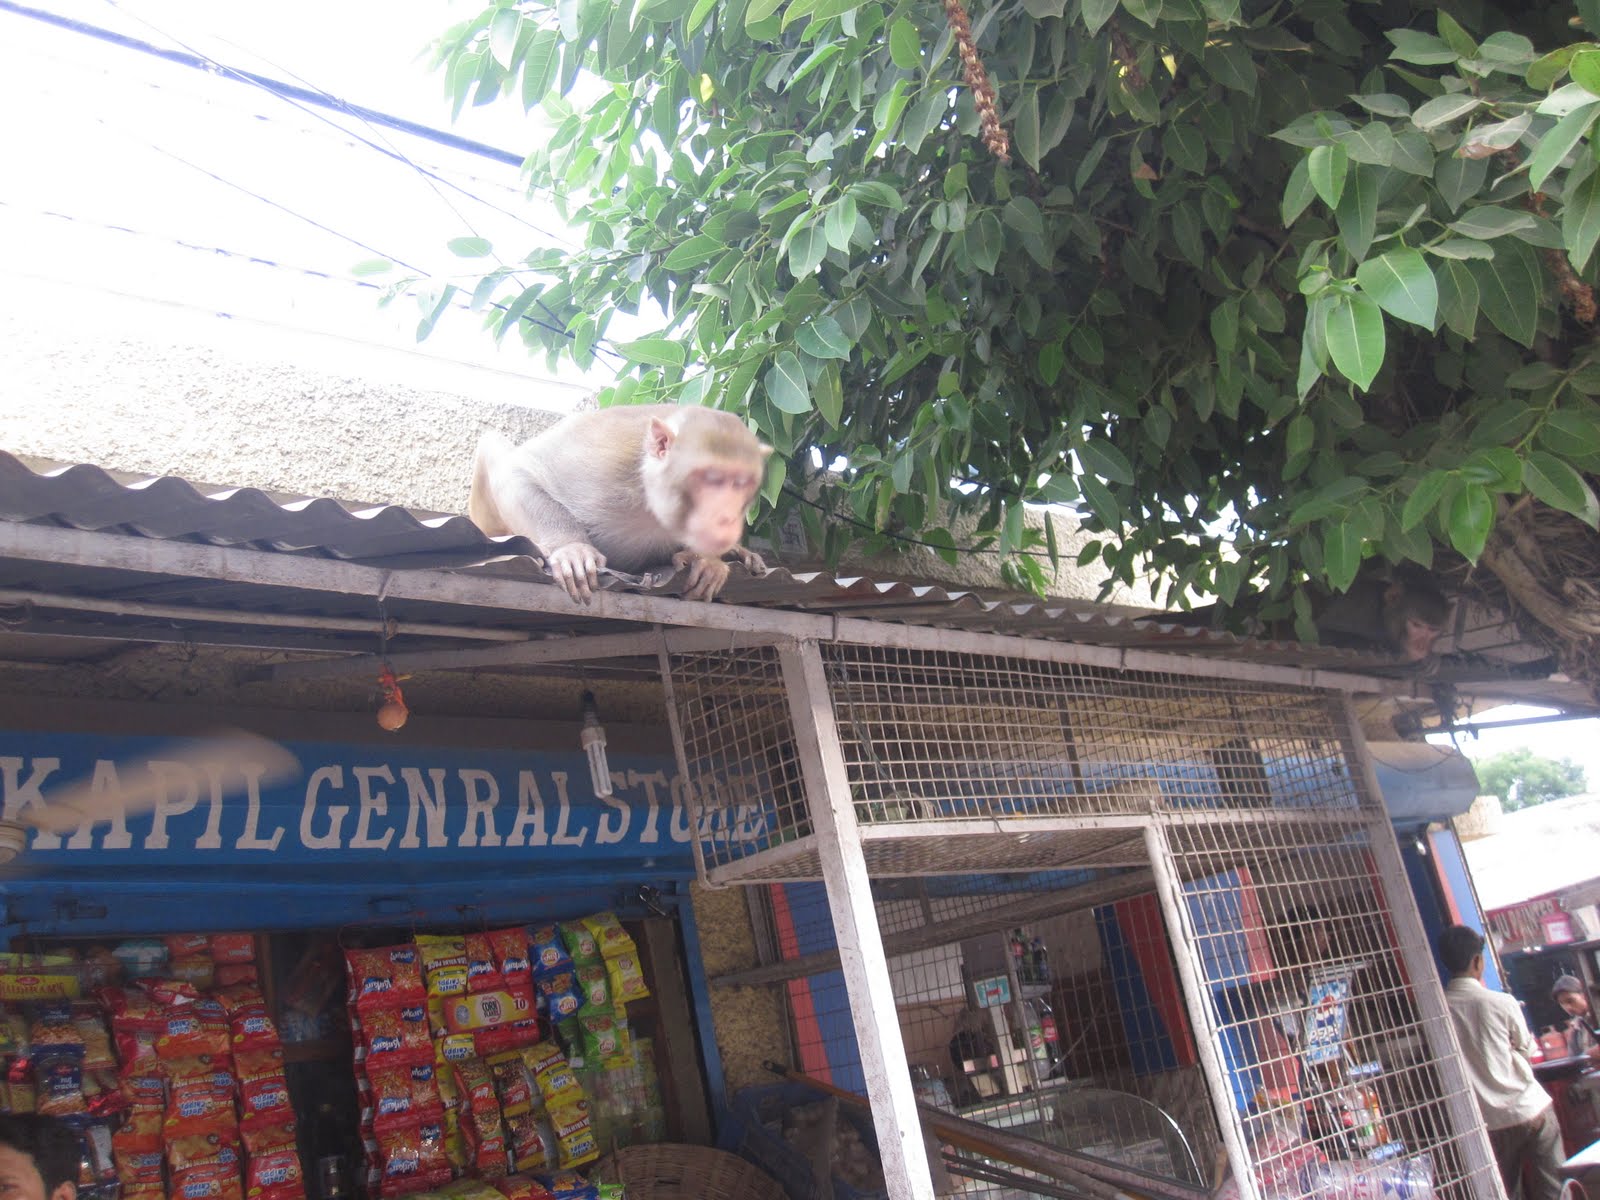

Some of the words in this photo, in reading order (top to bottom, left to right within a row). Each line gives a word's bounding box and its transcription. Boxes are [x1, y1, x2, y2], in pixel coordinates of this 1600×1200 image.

[0, 757, 285, 851] KAPIL
[299, 763, 588, 851] GENRAL
[595, 768, 764, 844] STORE
[515, 998, 526, 1010] 10
